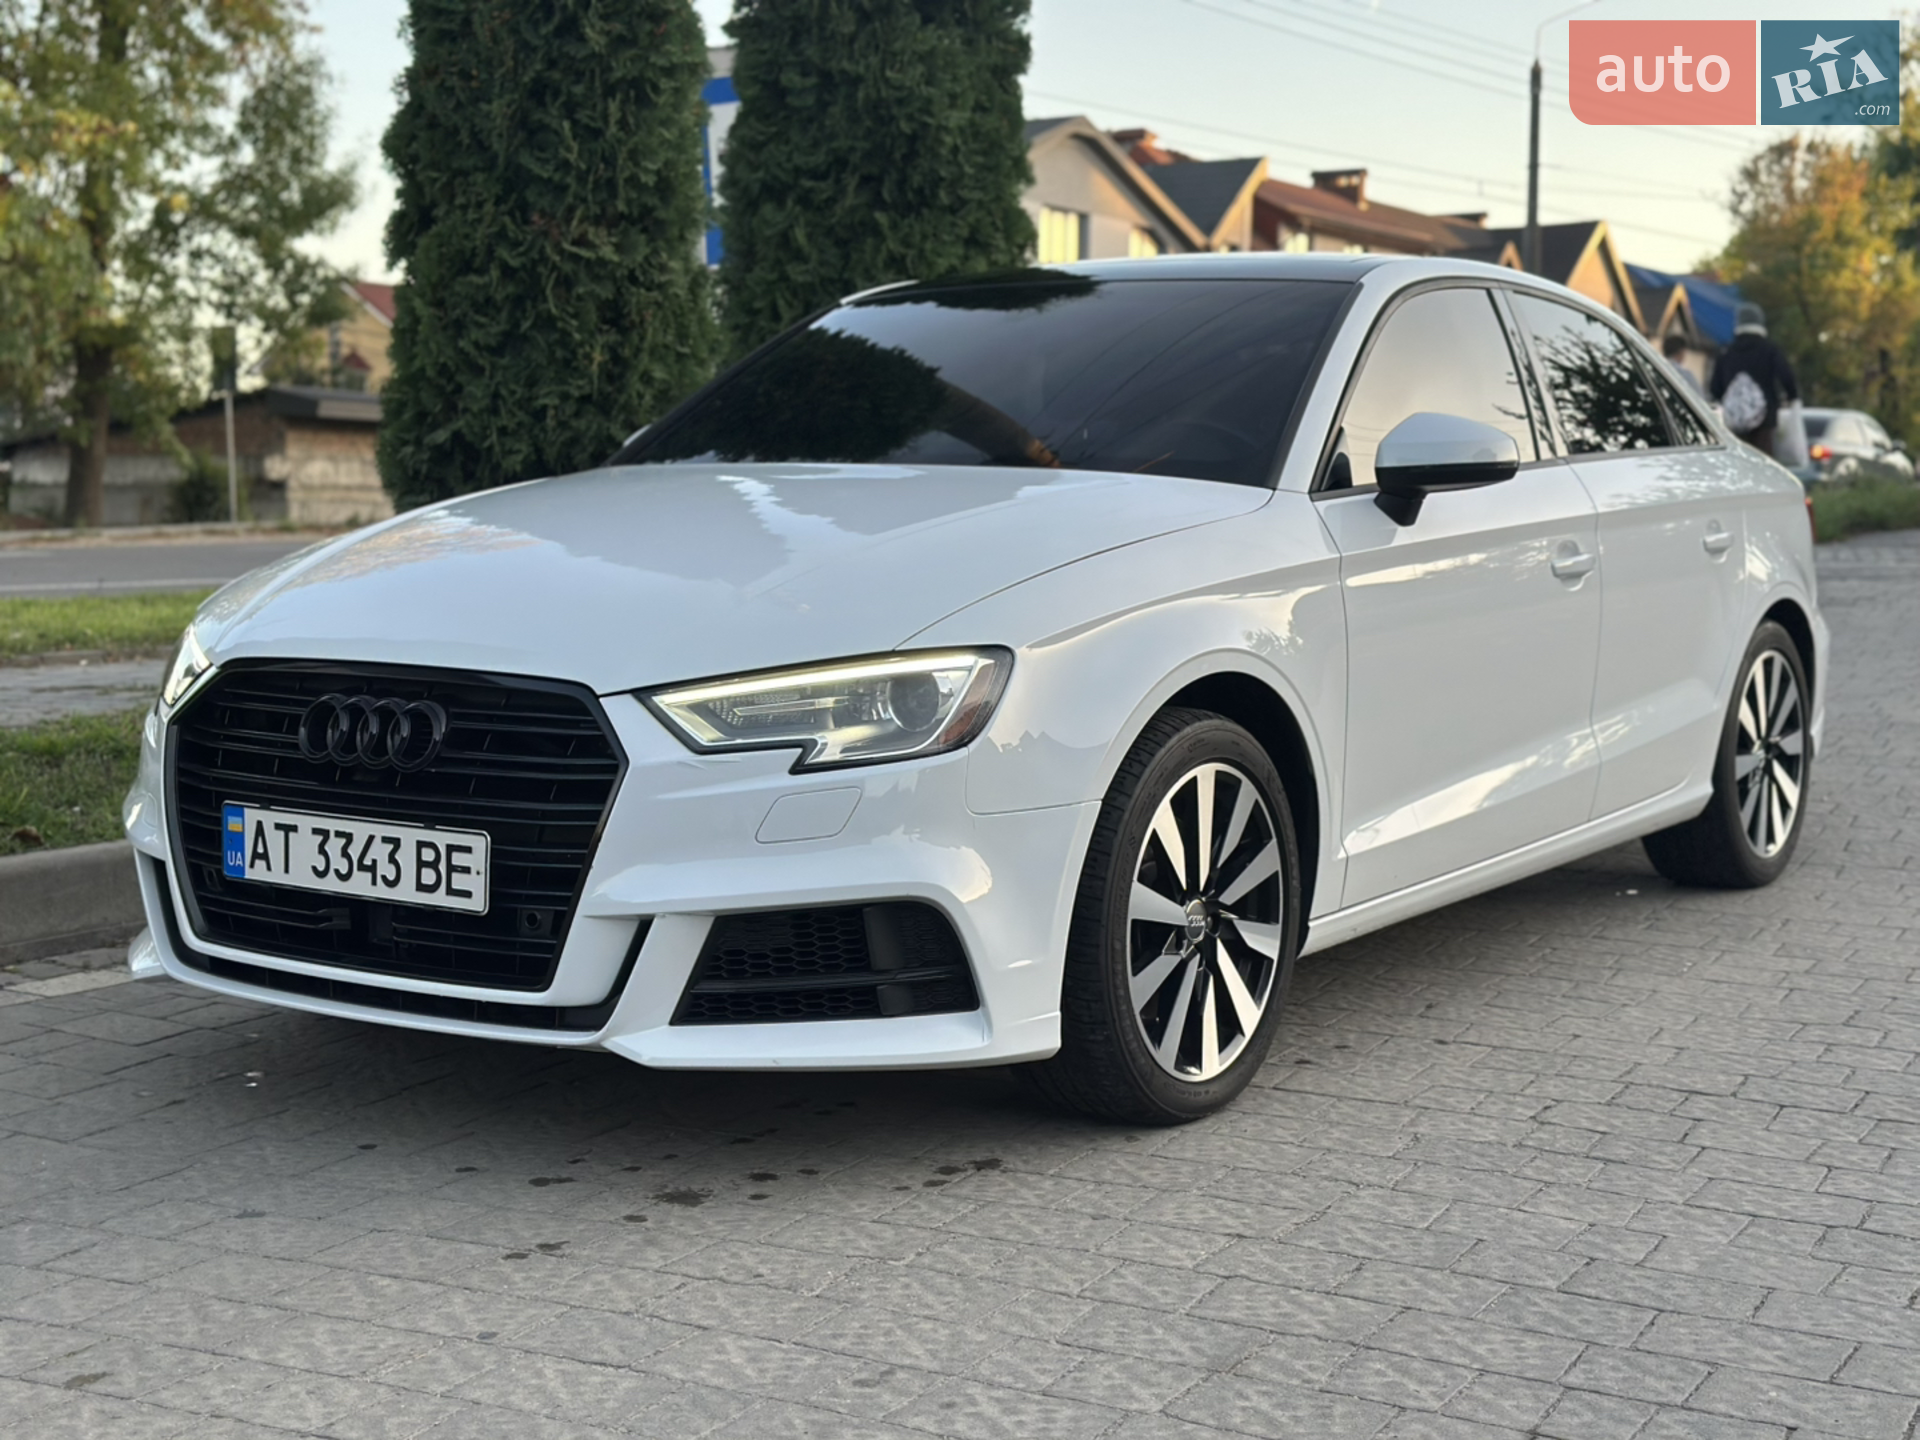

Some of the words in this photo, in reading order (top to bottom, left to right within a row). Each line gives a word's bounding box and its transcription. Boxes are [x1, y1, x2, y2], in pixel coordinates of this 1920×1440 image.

[227, 851, 244, 868] UA
[249, 819, 299, 875] AT
[310, 827, 402, 889] 3343
[415, 839, 473, 899] BE
